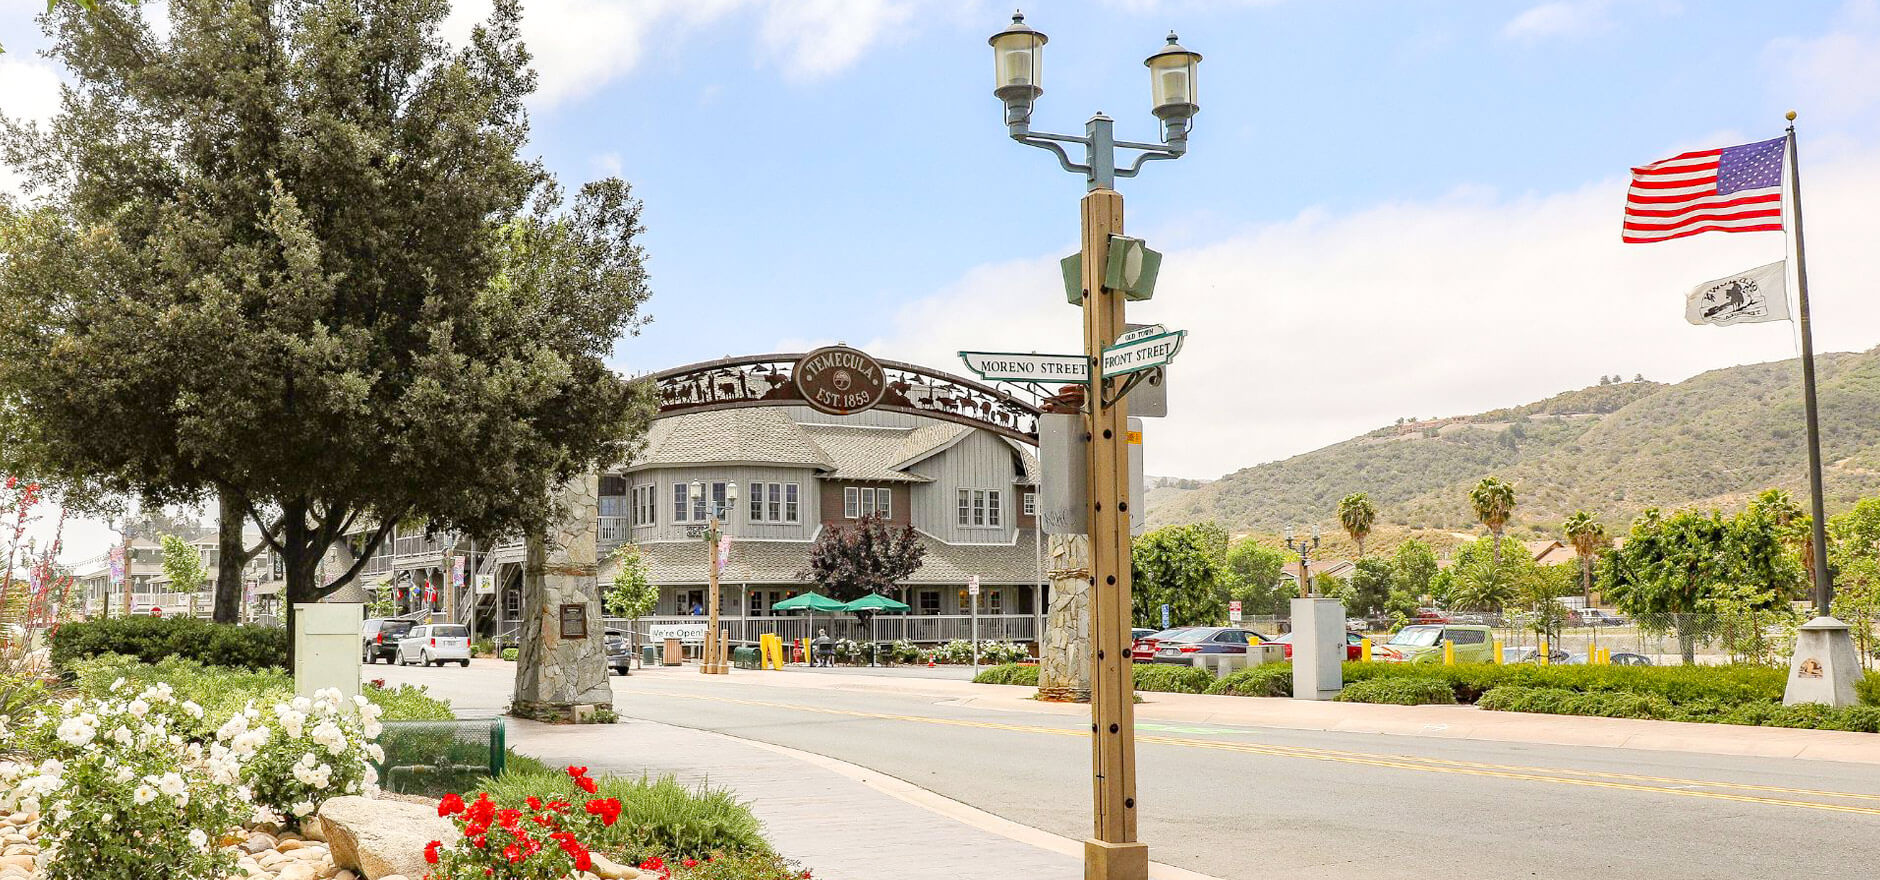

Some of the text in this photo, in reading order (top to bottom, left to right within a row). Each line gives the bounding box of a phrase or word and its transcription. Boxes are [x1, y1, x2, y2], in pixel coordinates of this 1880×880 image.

[1124, 328, 1154, 341] OLD TOWN
[1104, 343, 1171, 369] FRONT STREET
[806, 353, 873, 379] TEMECULA
[981, 360, 1087, 375] MORENO STREET
[816, 388, 869, 407] EST. 1859
[676, 629, 703, 637] Open!
